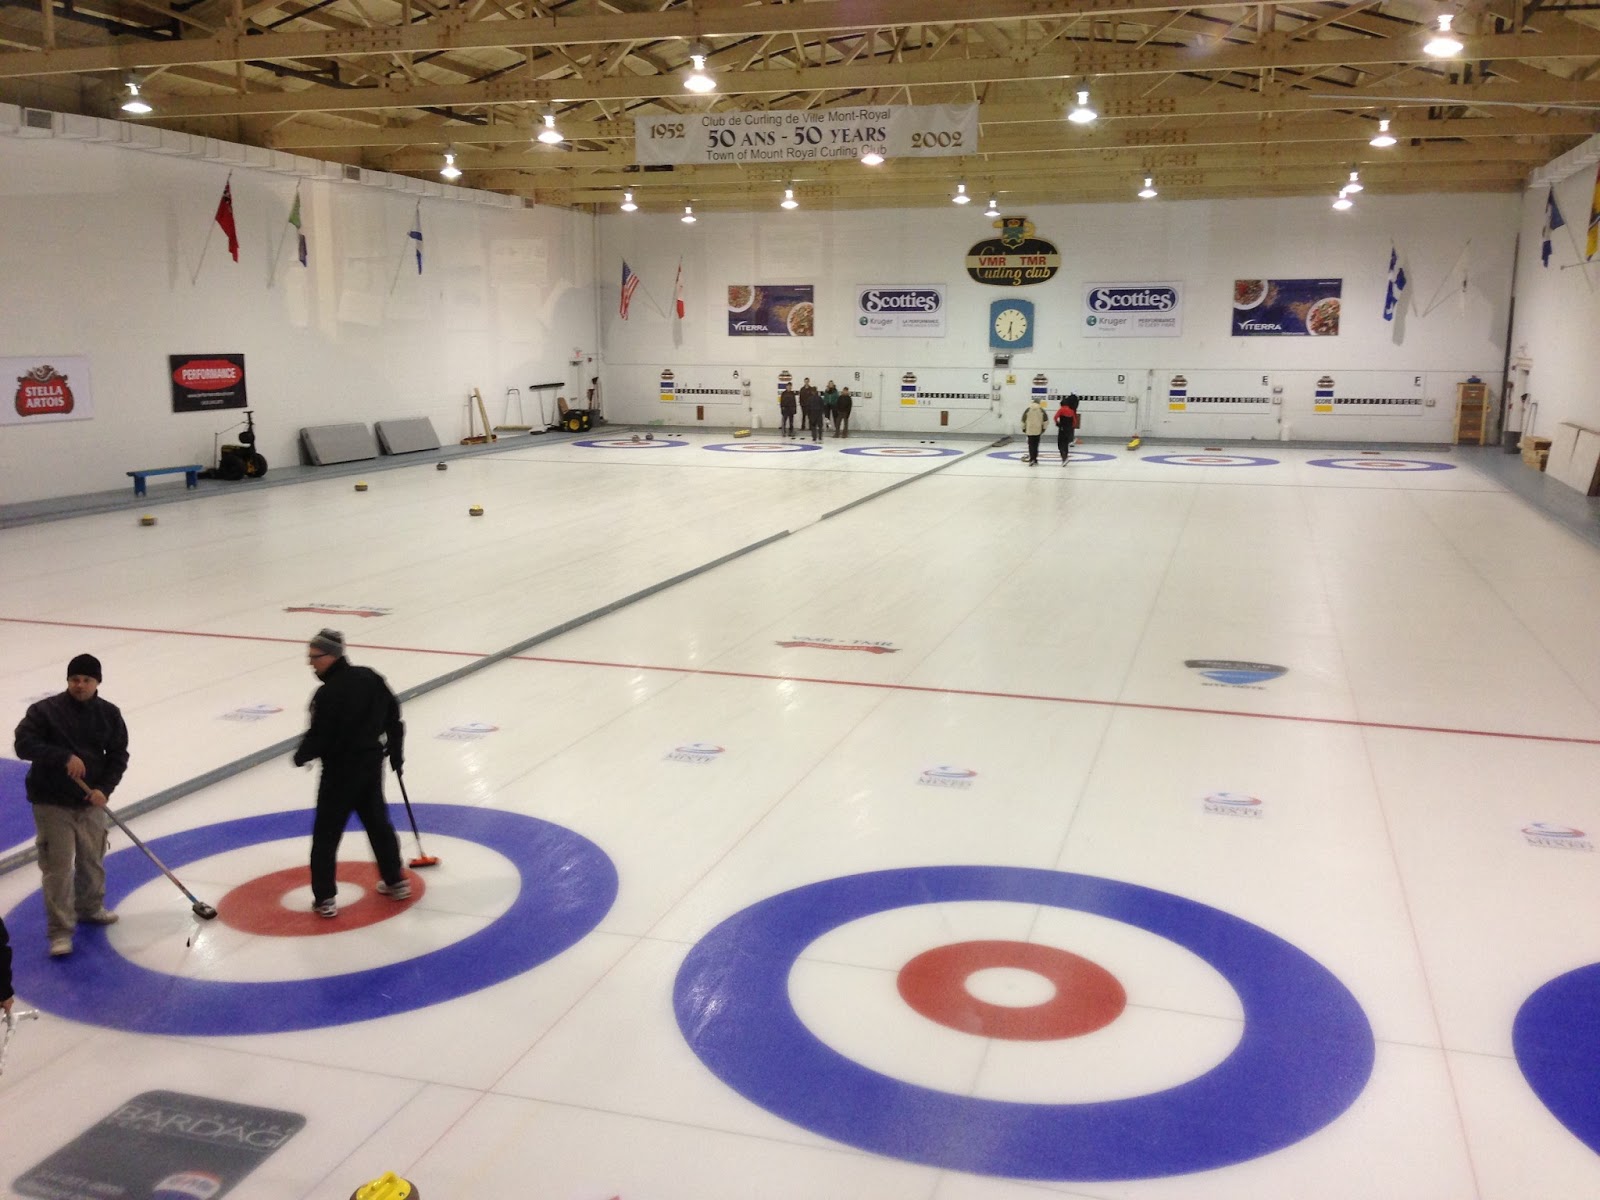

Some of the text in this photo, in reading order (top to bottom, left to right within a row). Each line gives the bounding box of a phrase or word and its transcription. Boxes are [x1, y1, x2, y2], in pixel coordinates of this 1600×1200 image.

[701, 109, 891, 127] Club de Curling de Ville Mont-Royal
[651, 122, 685, 140] 1952
[708, 128, 736, 148] 50
[740, 129, 776, 147] ANS
[793, 126, 823, 146] 50
[830, 126, 887, 144] YEARS
[911, 131, 963, 149] 2002
[706, 143, 887, 161] Town of Mount Royal Curling Club
[978, 256, 1047, 266] VMR TMR
[866, 290, 937, 313] Scotties
[1095, 287, 1173, 313] Scotties
[870, 318, 893, 326] Kruger
[1099, 317, 1127, 327] Kruger
[182, 368, 237, 380] PERFORMANCE
[25, 385, 63, 397] STELLA
[25, 397, 65, 409] ARTOIS
